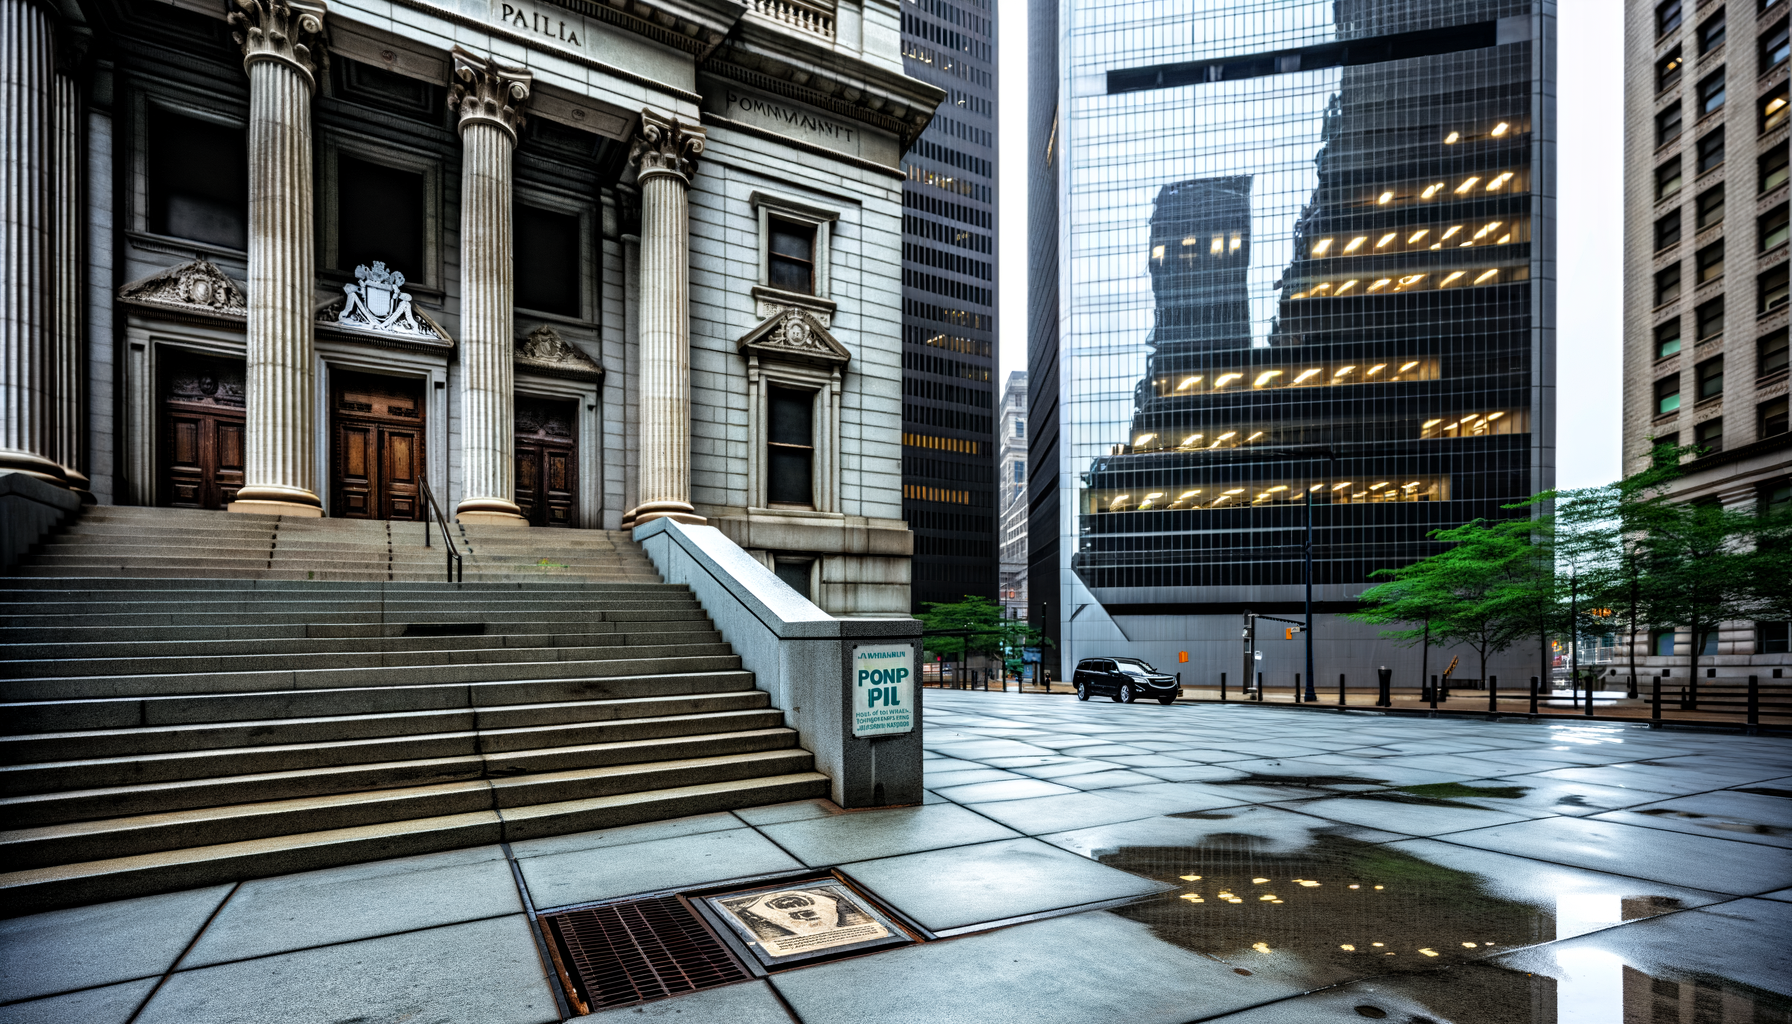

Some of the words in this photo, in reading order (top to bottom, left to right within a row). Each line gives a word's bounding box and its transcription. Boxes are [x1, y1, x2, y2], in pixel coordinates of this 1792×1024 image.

[501, 3, 581, 47] PAILIA
[858, 667, 909, 687] PONP
[868, 686, 901, 708] PIL
